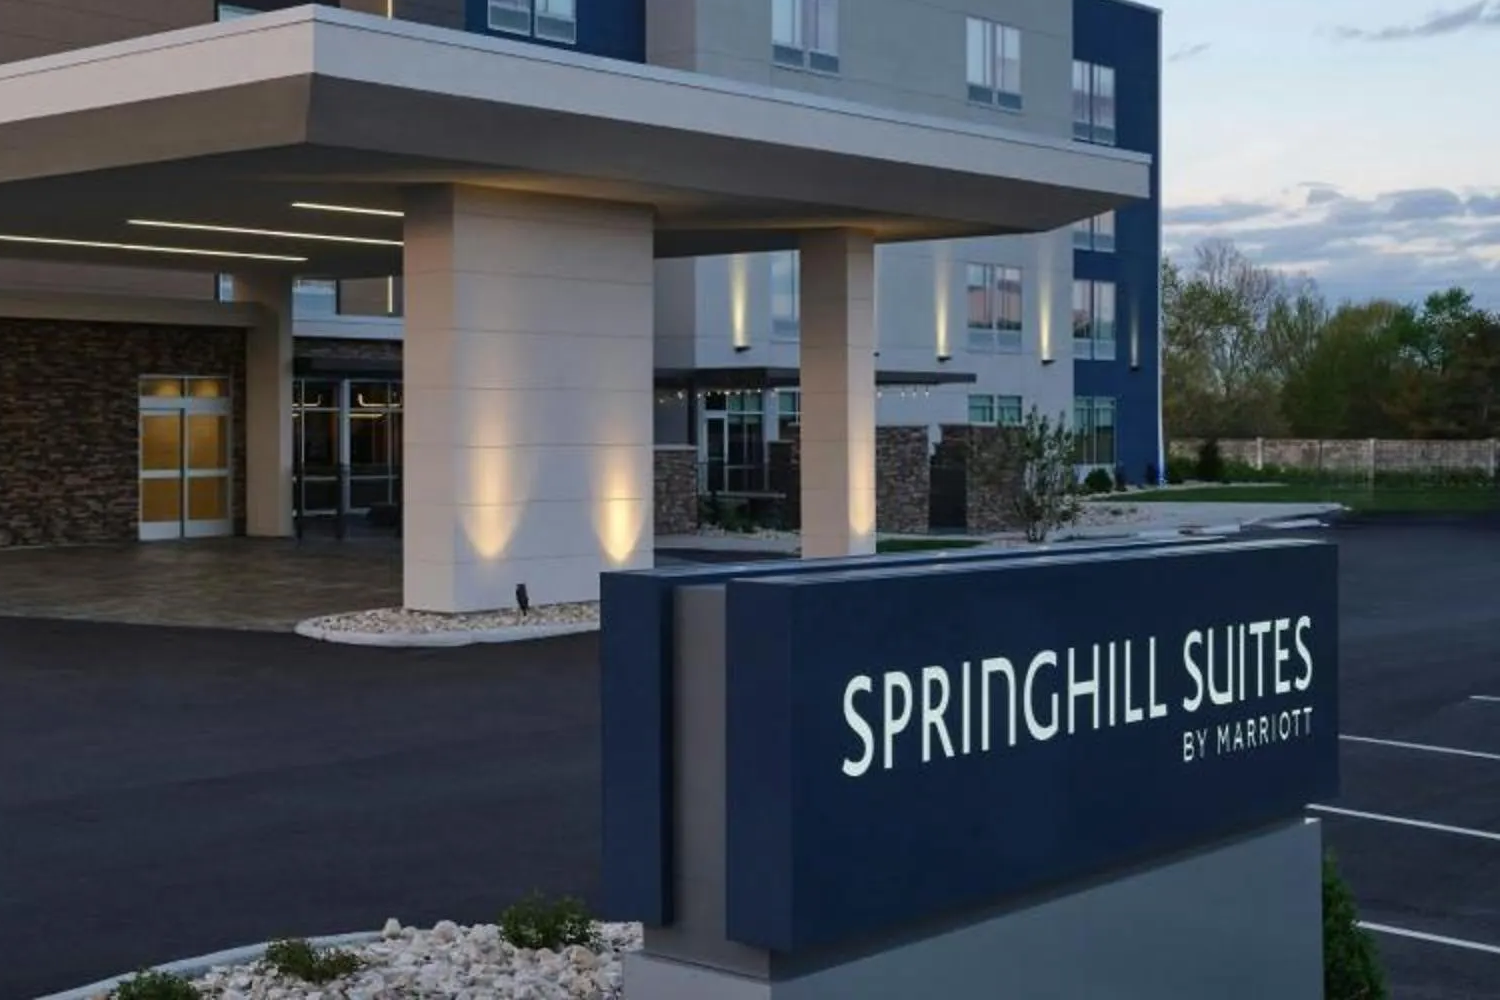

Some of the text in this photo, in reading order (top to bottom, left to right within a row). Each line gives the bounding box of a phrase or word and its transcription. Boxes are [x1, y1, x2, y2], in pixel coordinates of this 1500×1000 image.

[842, 615, 1313, 777] SPRINGHILL SUITES
[1183, 707, 1313, 762] BY MARRIOTT
